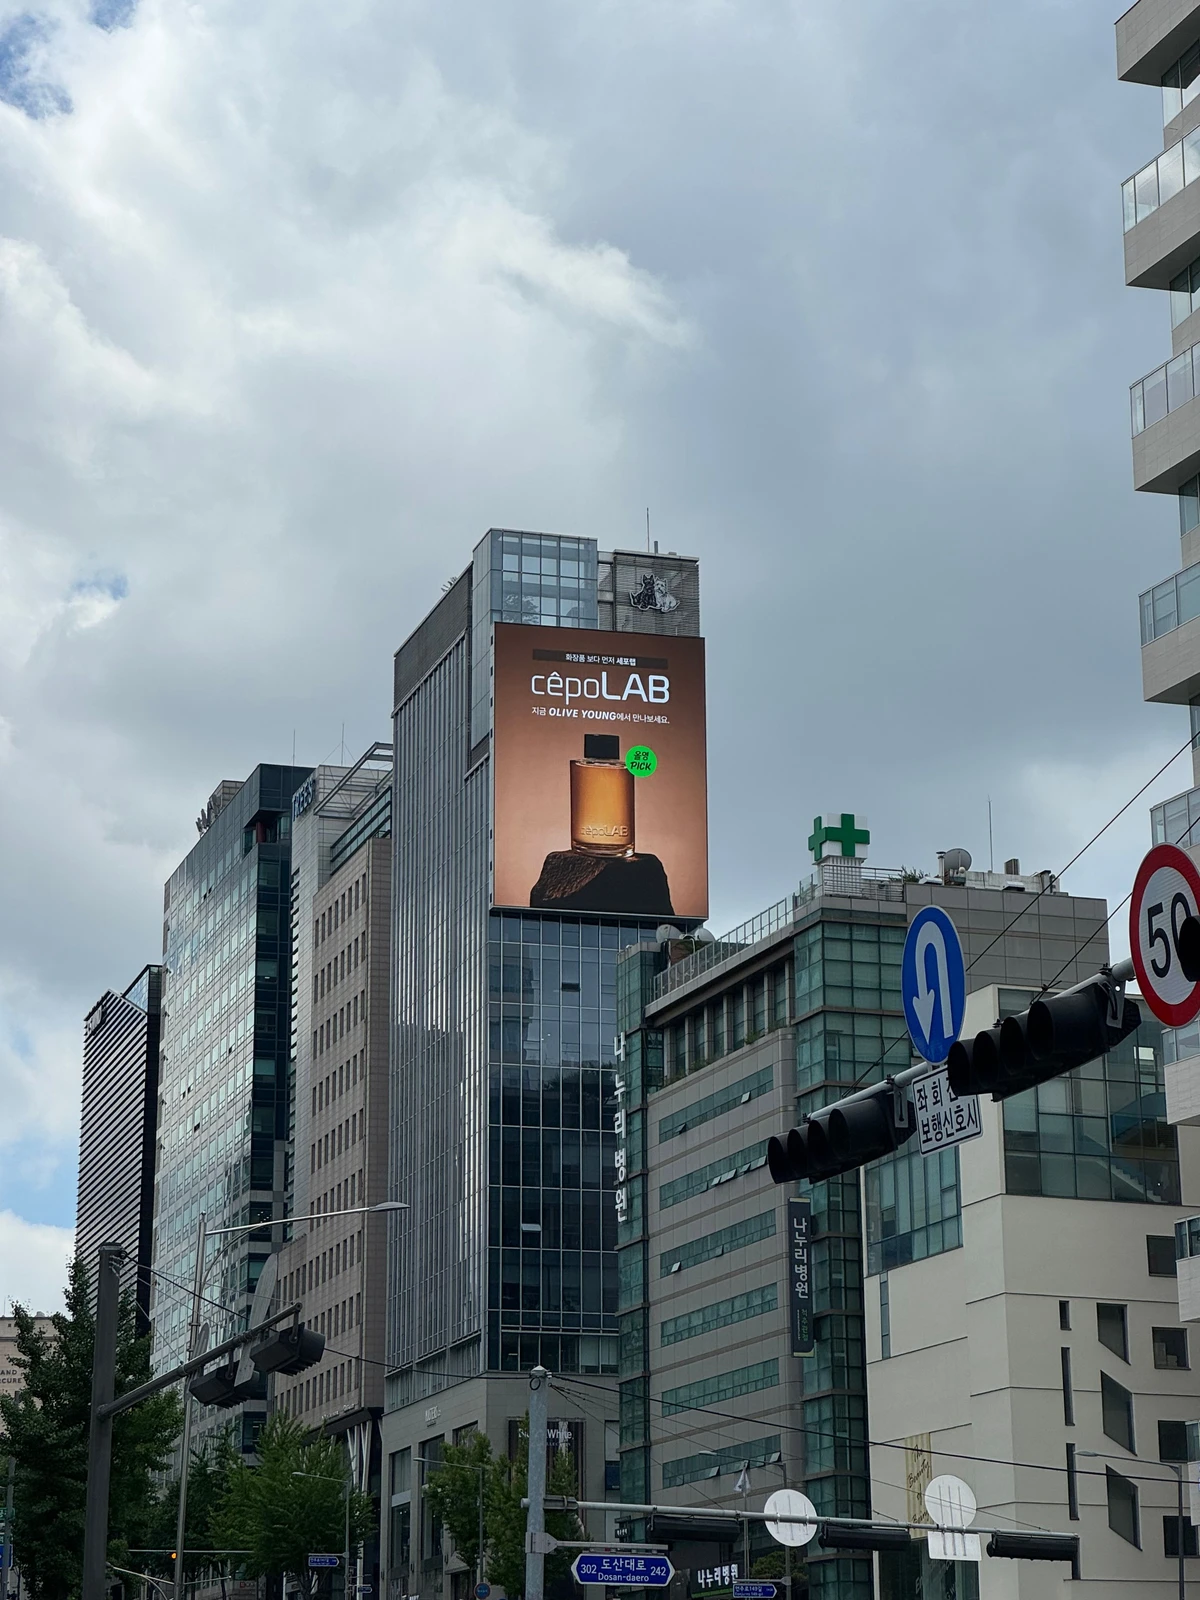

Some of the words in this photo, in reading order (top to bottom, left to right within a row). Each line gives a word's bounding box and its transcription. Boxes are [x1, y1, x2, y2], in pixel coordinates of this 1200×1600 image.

[565, 653, 586, 663] 화장품
[586, 654, 600, 664] 보다
[601, 656, 615, 665] 먼저
[616, 657, 637, 667] 세포랩
[531, 671, 670, 706] cêpoLAB
[531, 706, 547, 716] 지금
[548, 707, 579, 718] OLIVE
[581, 710, 631, 722] YOUNG에서
[632, 713, 670, 725] 만나보세요.
[630, 761, 652, 771] PICK
[1147, 892, 1192, 979] 50
[613, 1031, 628, 1223] 나누리병원
[921, 1098, 978, 1145] 보행신호시
[793, 1216, 809, 1299] 나누리병원
[580, 1564, 597, 1574] 302
[600, 1558, 647, 1572] 도산대로
[650, 1566, 667, 1576] 242
[598, 1572, 650, 1582] Dosan-daero
[697, 1563, 739, 1589] 나누리병원
